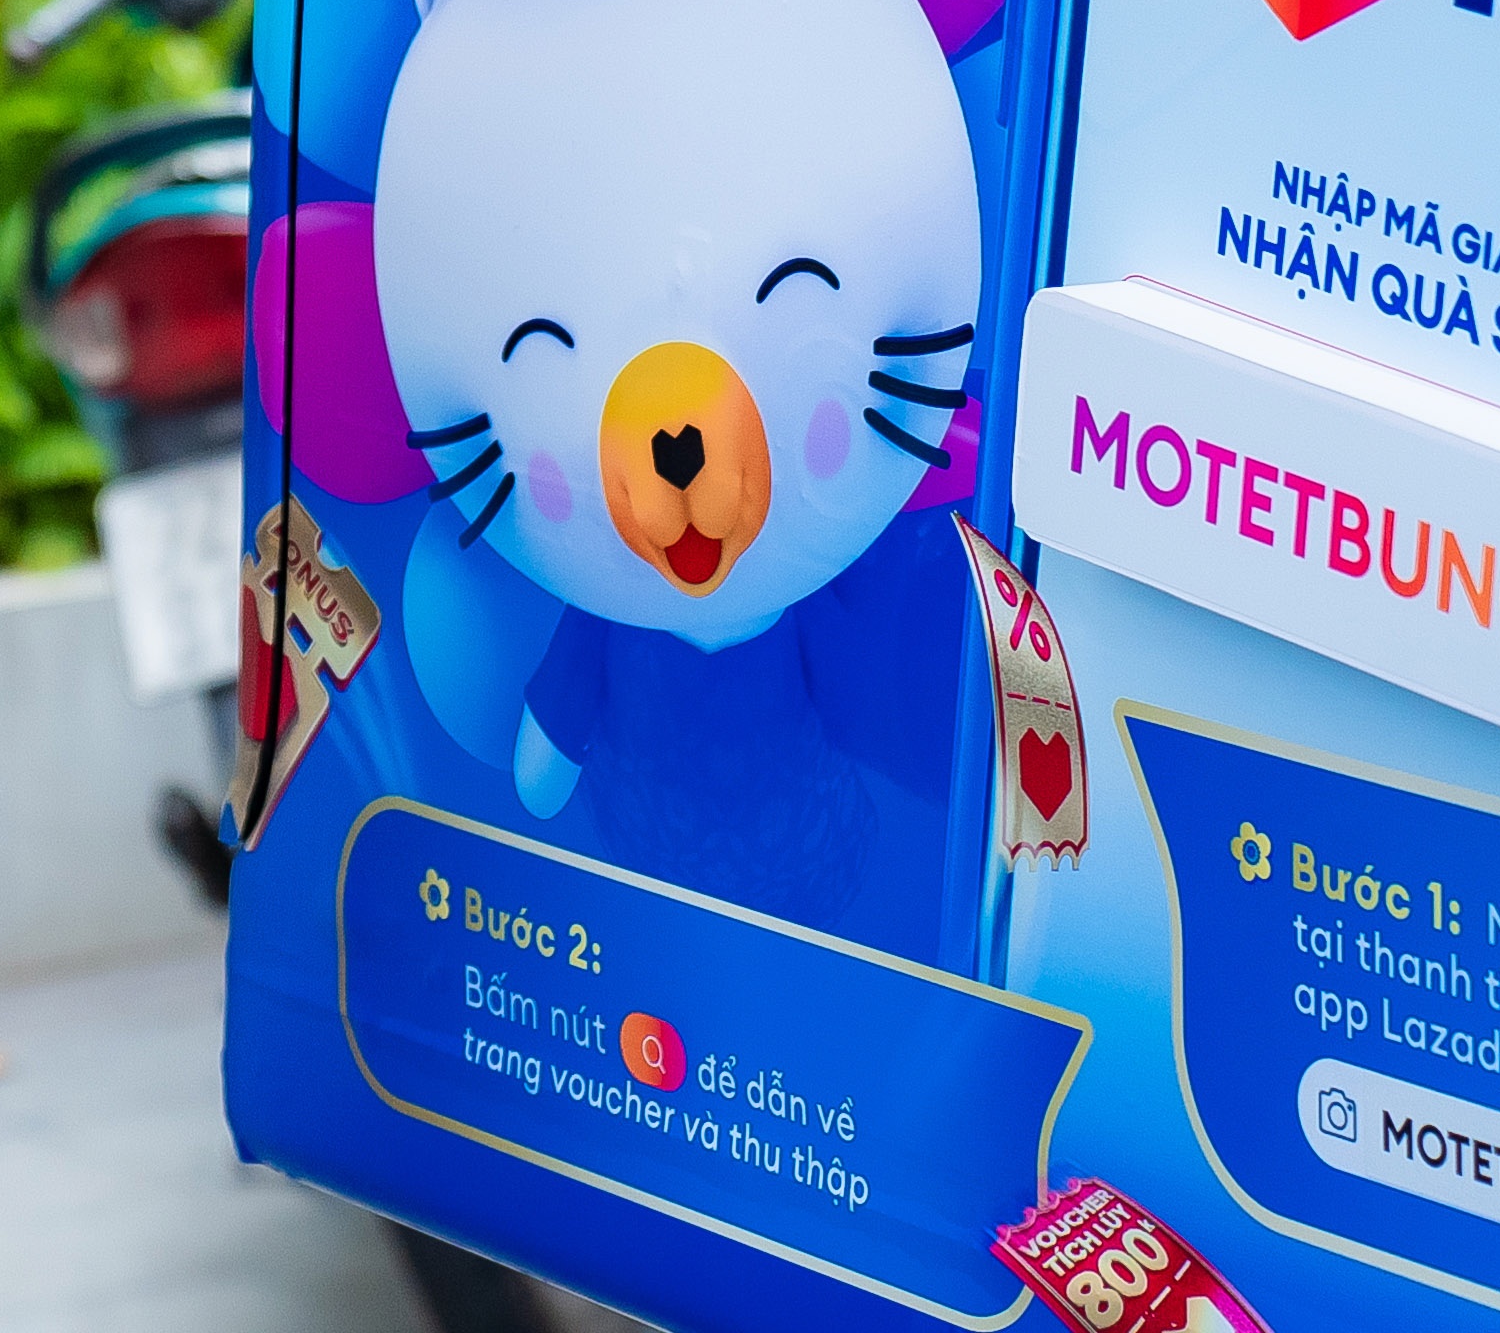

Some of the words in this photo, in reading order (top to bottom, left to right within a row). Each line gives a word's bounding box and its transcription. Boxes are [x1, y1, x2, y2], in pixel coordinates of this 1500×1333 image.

[1272, 160, 1377, 233] NHẬP
[1384, 201, 1443, 255] MÃ
[1217, 205, 1360, 302] NHẬN
[1371, 263, 1481, 346] QUÀ
[286, 539, 355, 647] ONUS
[464, 886, 557, 958] Bước
[568, 923, 602, 975] 2:
[1291, 841, 1412, 921] Bước
[1426, 881, 1462, 935] 1:
[1293, 914, 1344, 969] tại
[1355, 929, 1473, 1003] thanh
[463, 964, 539, 1030] Bấm
[550, 1004, 607, 1055] nút
[697, 1053, 737, 1100] để
[746, 1069, 808, 1127] dẫn
[816, 1095, 857, 1142] về
[1294, 982, 1369, 1040] app
[463, 1026, 541, 1096] trang
[550, 1063, 676, 1134] voucher
[683, 1110, 719, 1151] và
[729, 1123, 780, 1175] thu
[791, 1146, 870, 1212] thập
[1018, 1189, 1116, 1259] VOUCHER
[1041, 1230, 1103, 1277] TÍCH
